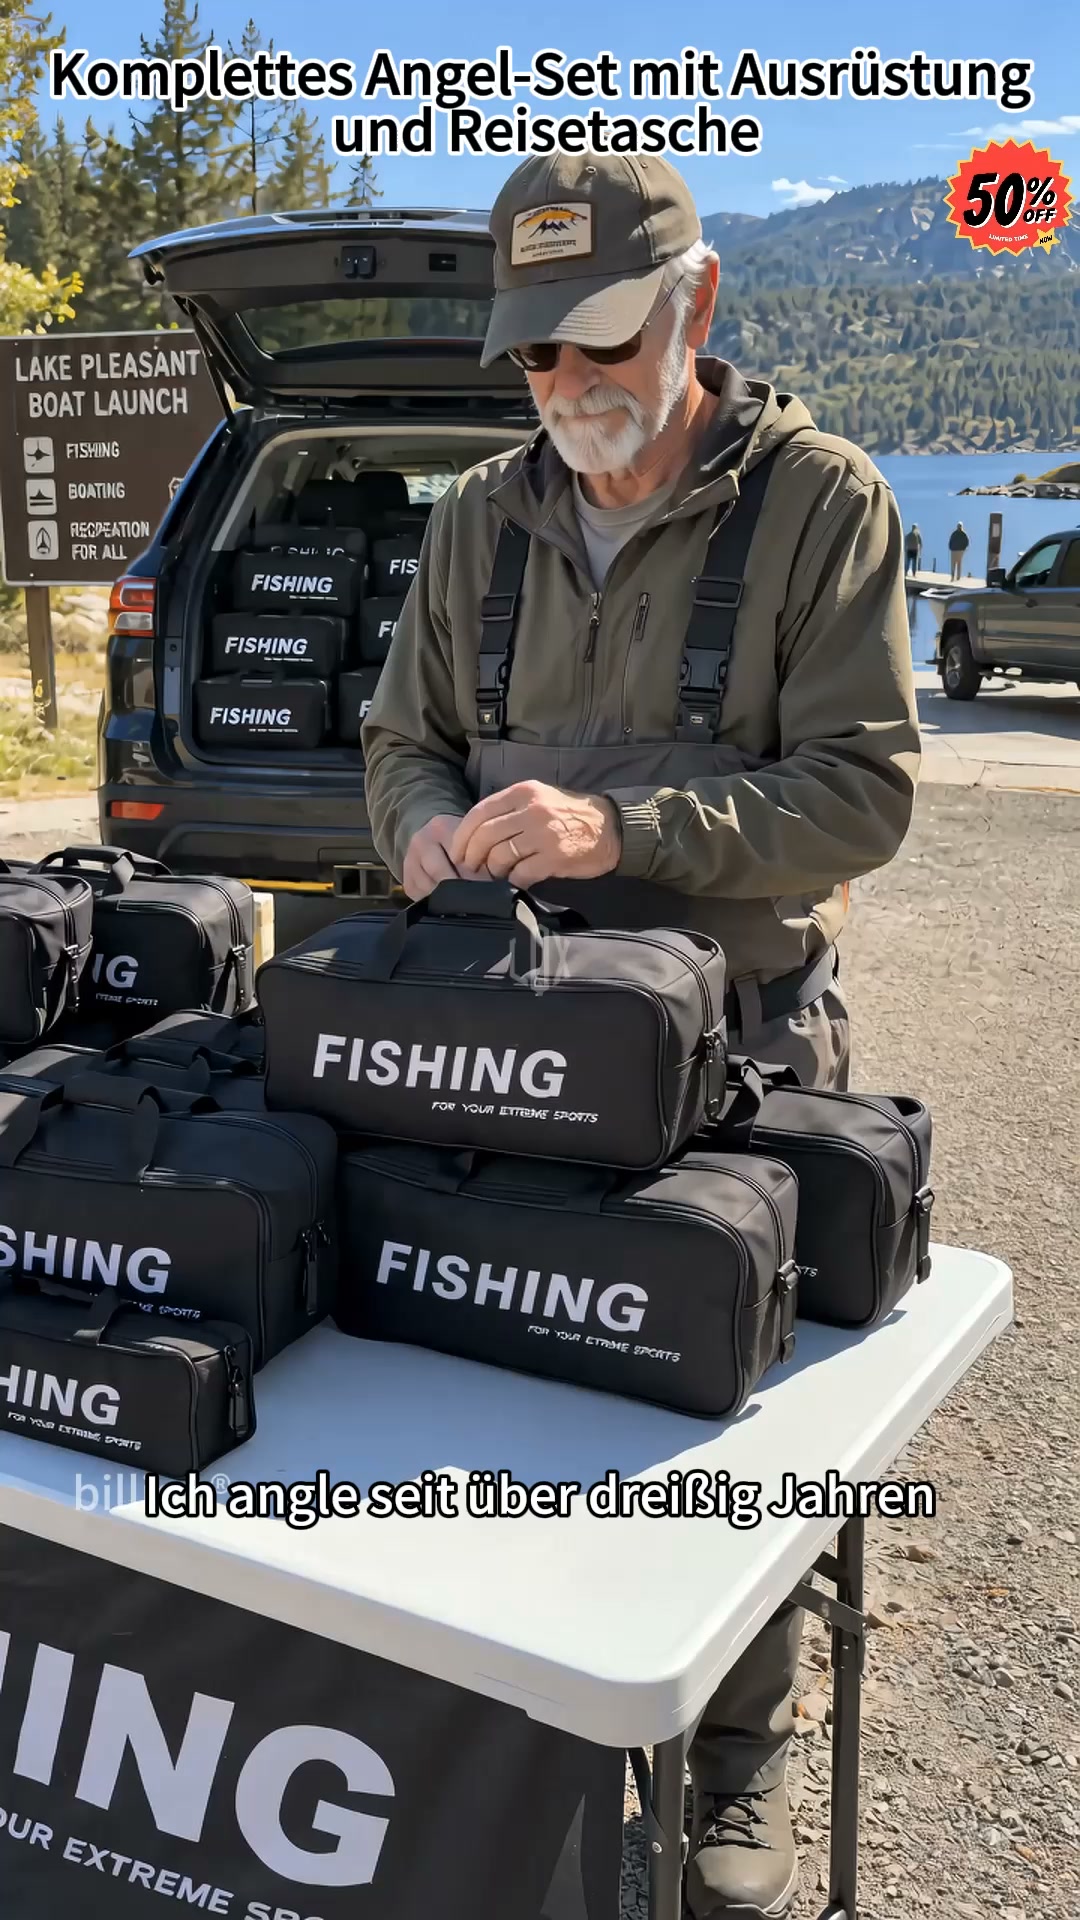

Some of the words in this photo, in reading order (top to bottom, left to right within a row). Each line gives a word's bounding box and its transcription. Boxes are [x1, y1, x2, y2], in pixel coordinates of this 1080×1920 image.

[15, 355, 73, 382] LAKE
[80, 349, 201, 380] PLEASANT
[28, 391, 86, 418] BOAT
[93, 387, 189, 417] LAUNCH
[66, 441, 121, 459] FISHING
[68, 482, 126, 500] BOATING
[71, 543, 98, 561] FOR
[101, 543, 128, 560] ALL
[251, 573, 335, 593] FISHING
[224, 636, 309, 655] FISHING
[209, 706, 292, 726] FISHING
[312, 1032, 568, 1099] FISHING
[375, 1239, 650, 1333] FISHING
[0, 1630, 396, 1887] ING
[62, 1836, 235, 1915] EXTREME
